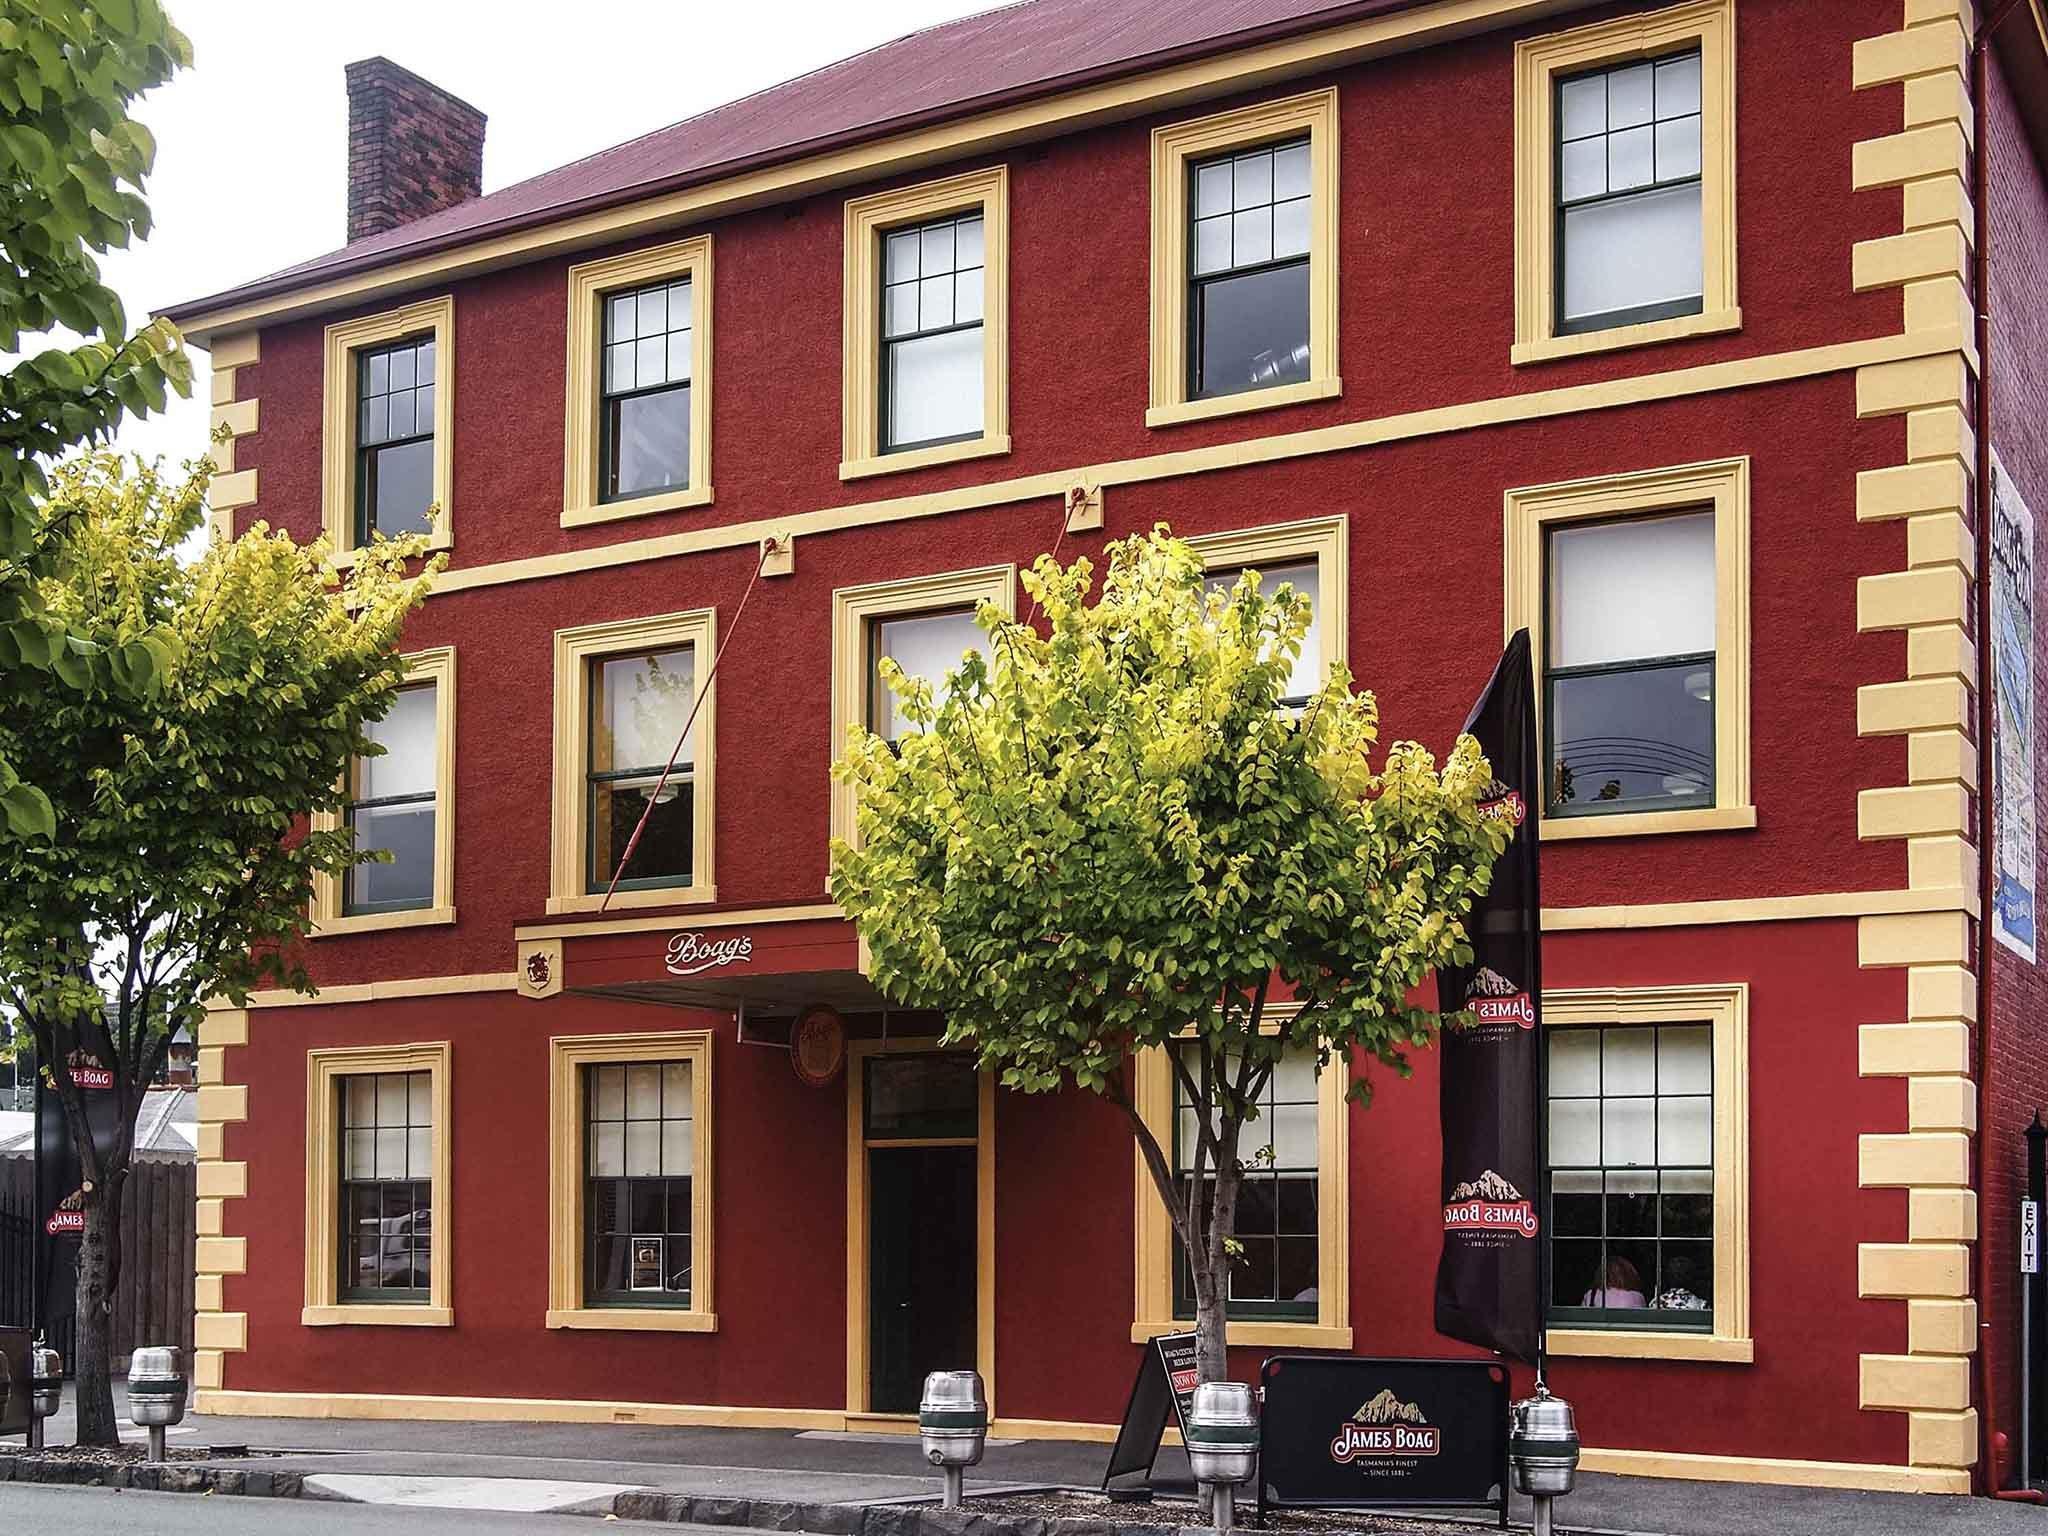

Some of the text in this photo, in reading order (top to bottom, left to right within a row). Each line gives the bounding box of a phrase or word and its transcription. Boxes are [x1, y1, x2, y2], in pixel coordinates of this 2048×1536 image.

[665, 932, 752, 975] Boag's
[83, 1070, 109, 1084] BOAG
[2025, 1208, 2034, 1267] EXIT
[1174, 1374, 1190, 1387] NOW
[1334, 1428, 1433, 1456] JAMES BOAG
